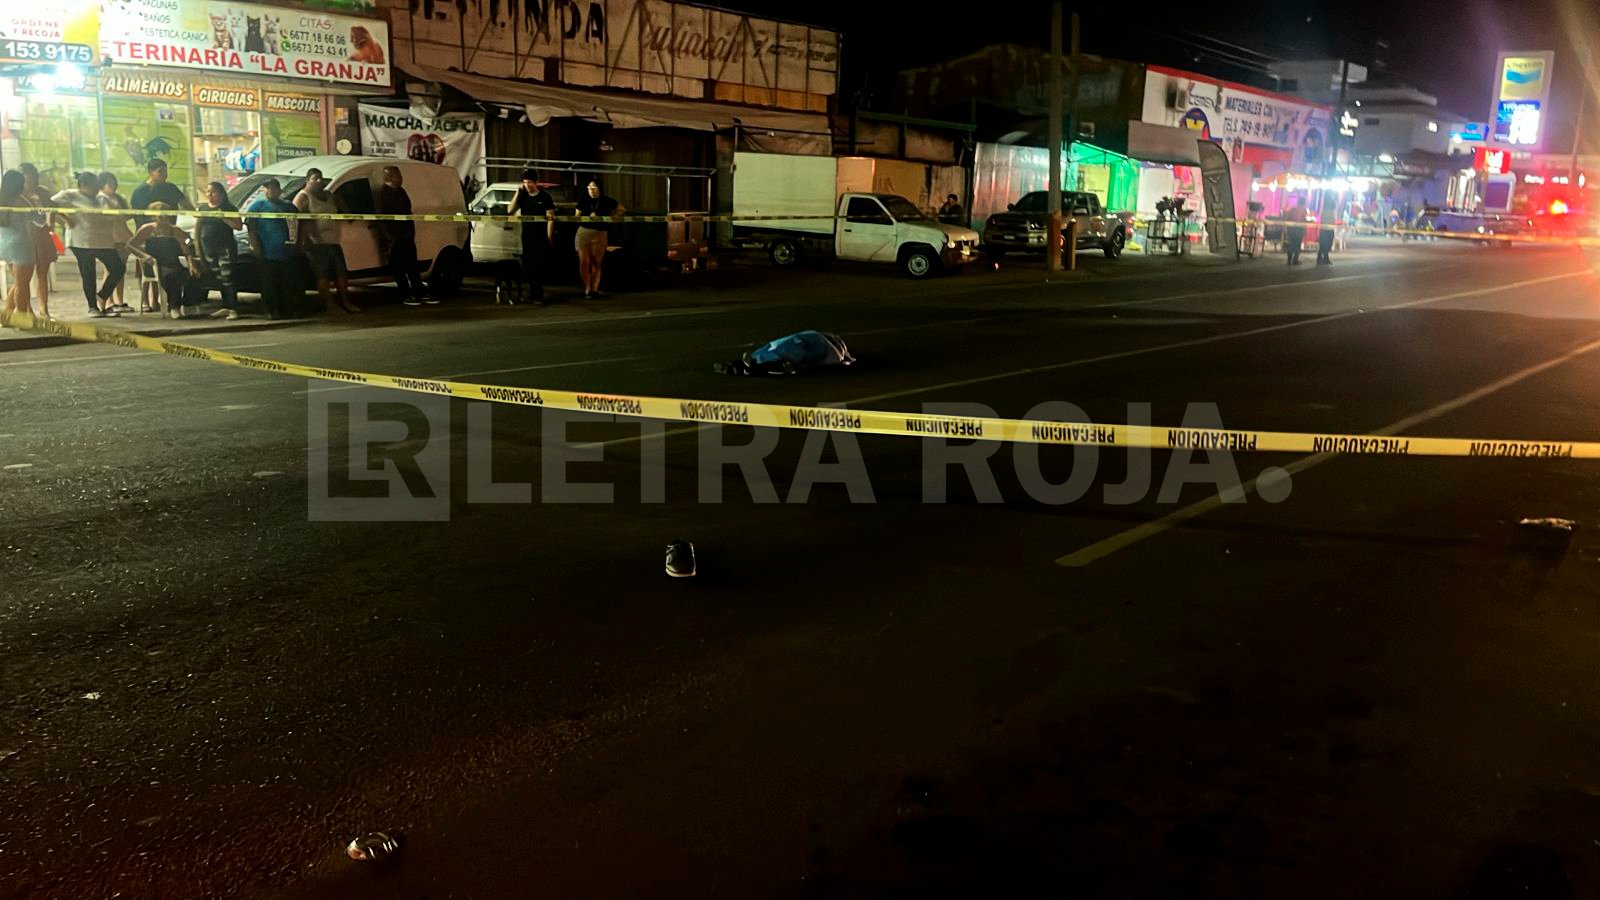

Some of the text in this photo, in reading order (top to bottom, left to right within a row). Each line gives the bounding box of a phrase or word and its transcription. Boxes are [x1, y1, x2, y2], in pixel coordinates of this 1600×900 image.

[22, 28, 60, 37] RECOJA
[5, 41, 91, 62] 153 9175
[105, 77, 184, 97] ALIMENTOS
[199, 89, 254, 106] CIRUGIAS
[267, 96, 321, 112] MASCOTAS
[1225, 96, 1263, 116] MATERIALES
[365, 114, 422, 131] MARCHA
[576, 393, 642, 414] PRECAUCION
[680, 400, 748, 423] PRECAUCION
[790, 408, 861, 429] PRECAUCION
[906, 418, 983, 437] PRECAUCION
[1031, 424, 1115, 444] PRECAUCION
[1168, 429, 1257, 451] PRECAUCION
[1313, 436, 1409, 455] PRECAUCION
[1468, 442, 1573, 459] PRECAUCION
